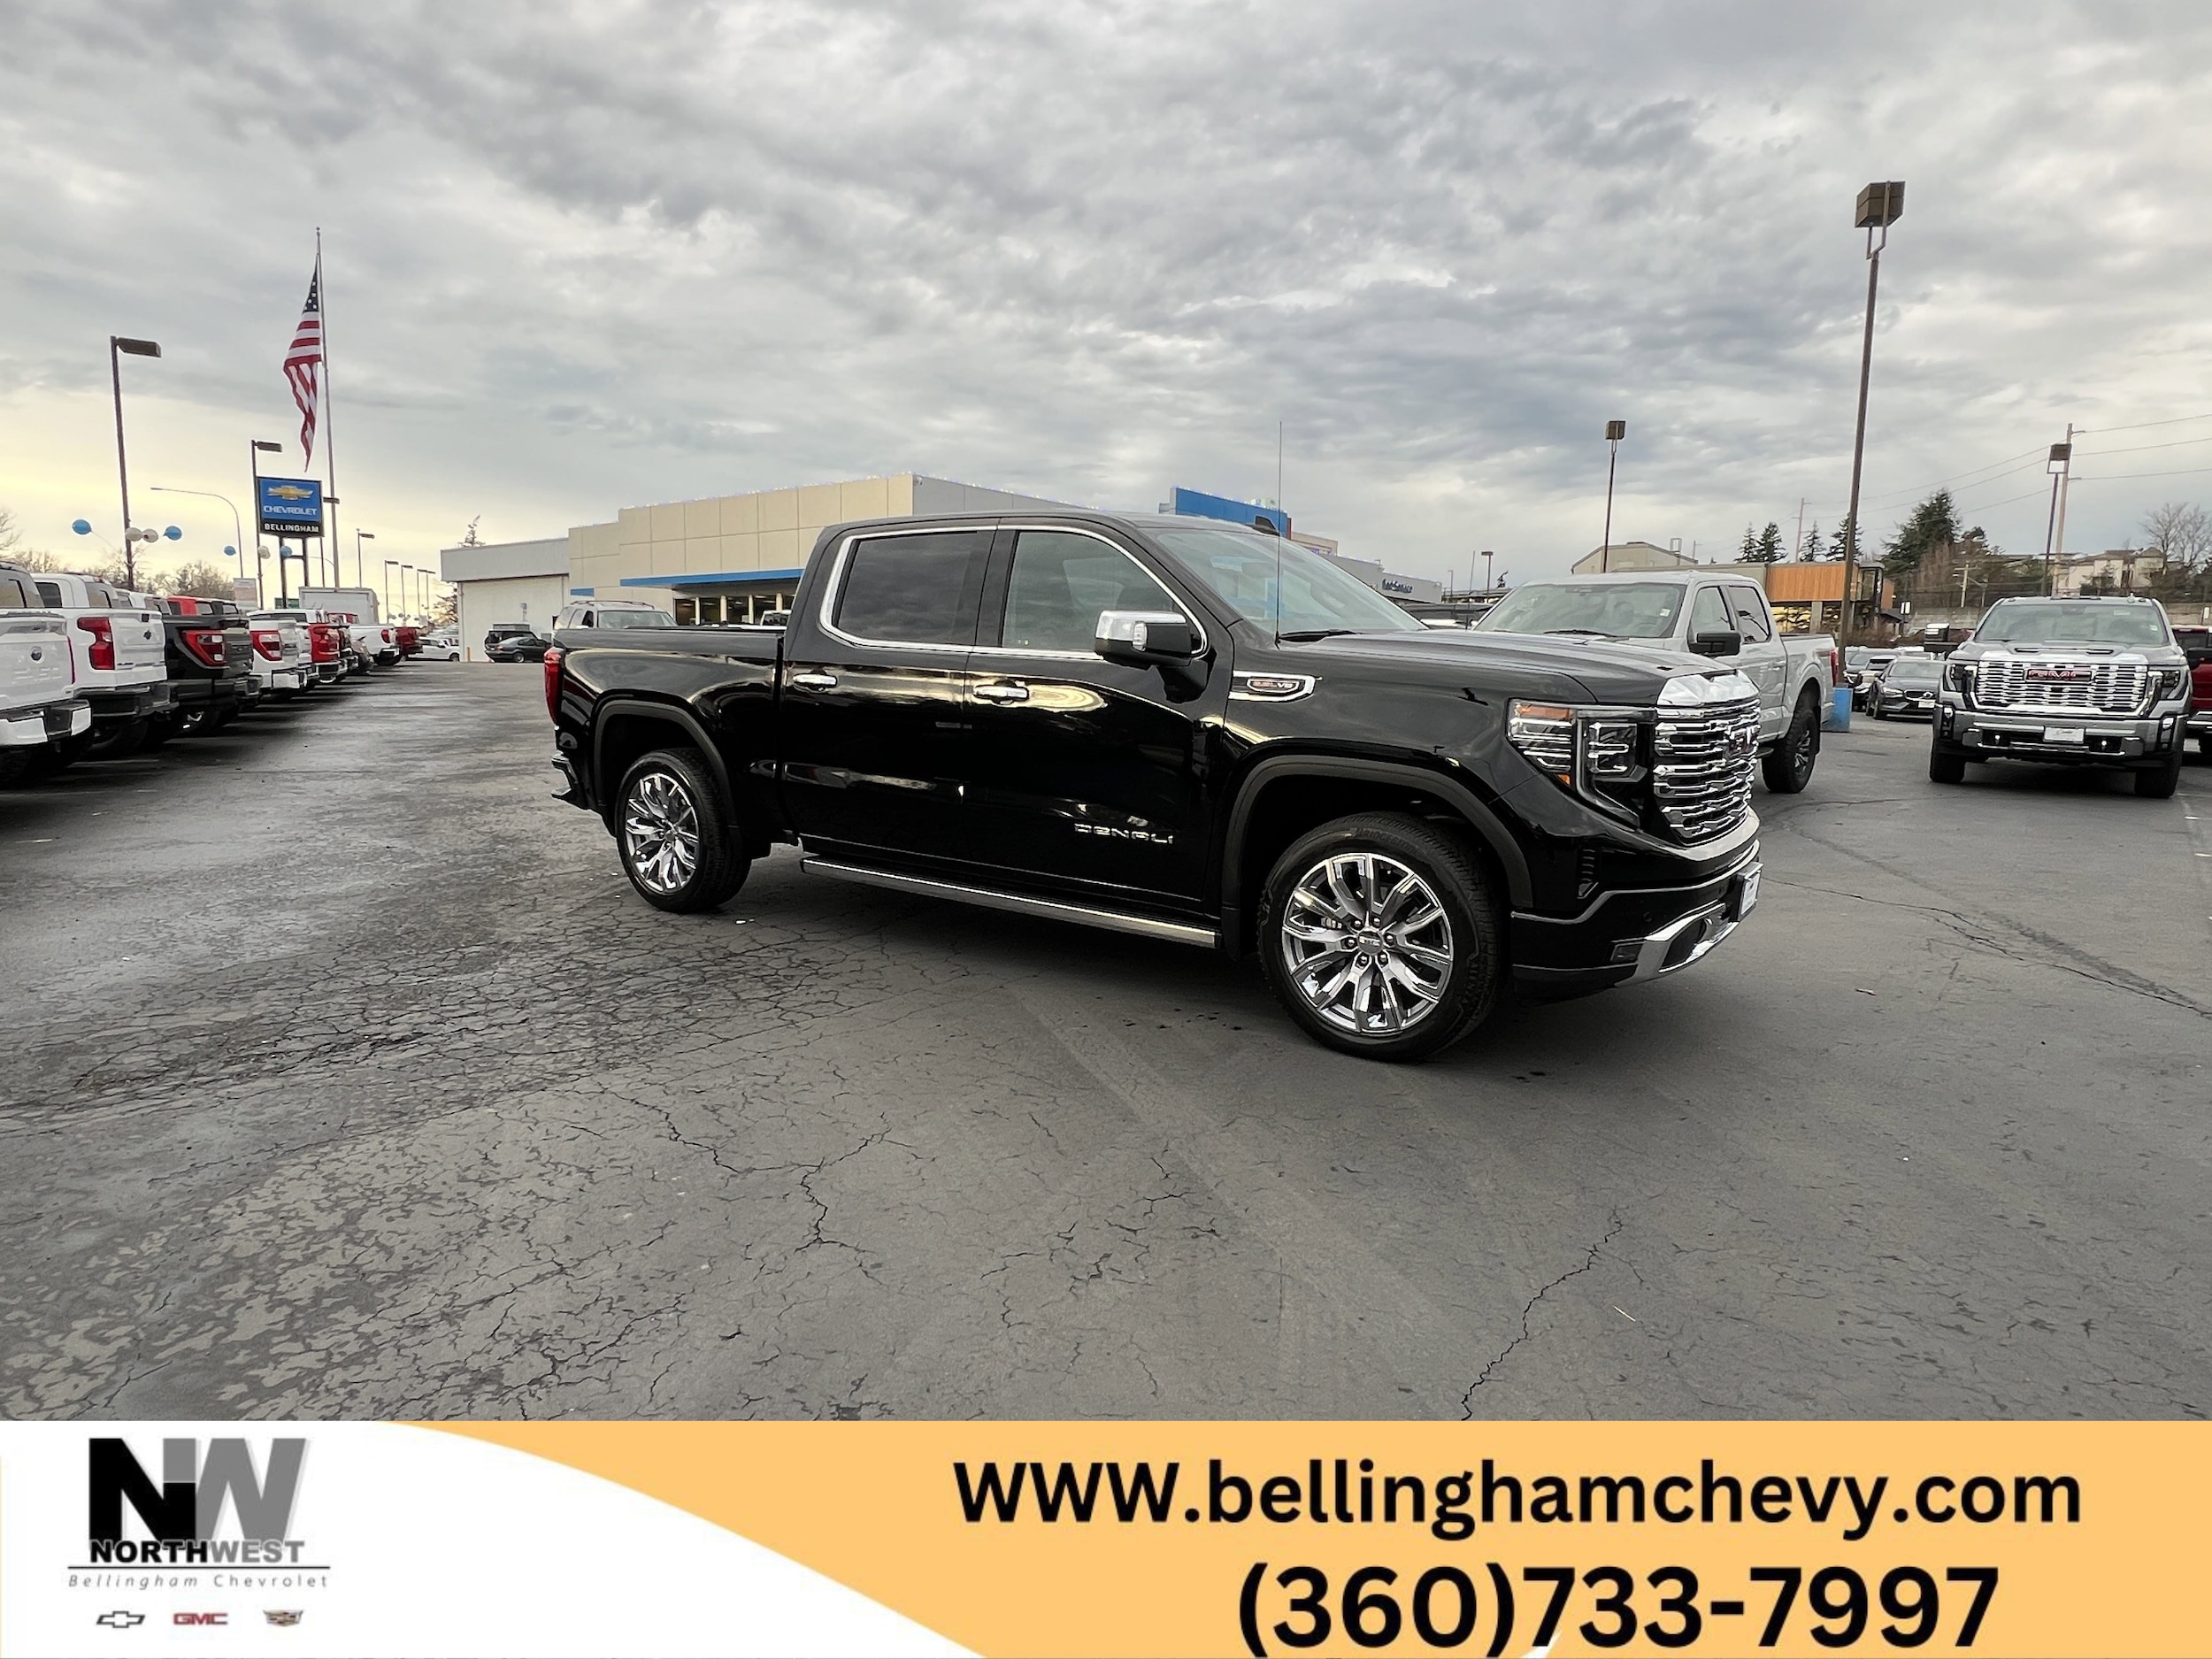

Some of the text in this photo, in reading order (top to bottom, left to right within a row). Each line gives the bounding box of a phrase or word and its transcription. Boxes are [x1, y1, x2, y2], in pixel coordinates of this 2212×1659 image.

[263, 505, 318, 516] CHEVROLET
[264, 523, 319, 533] BELLINGHAM
[2028, 670, 2091, 680] GMC
[1074, 823, 1174, 844] DENALI
